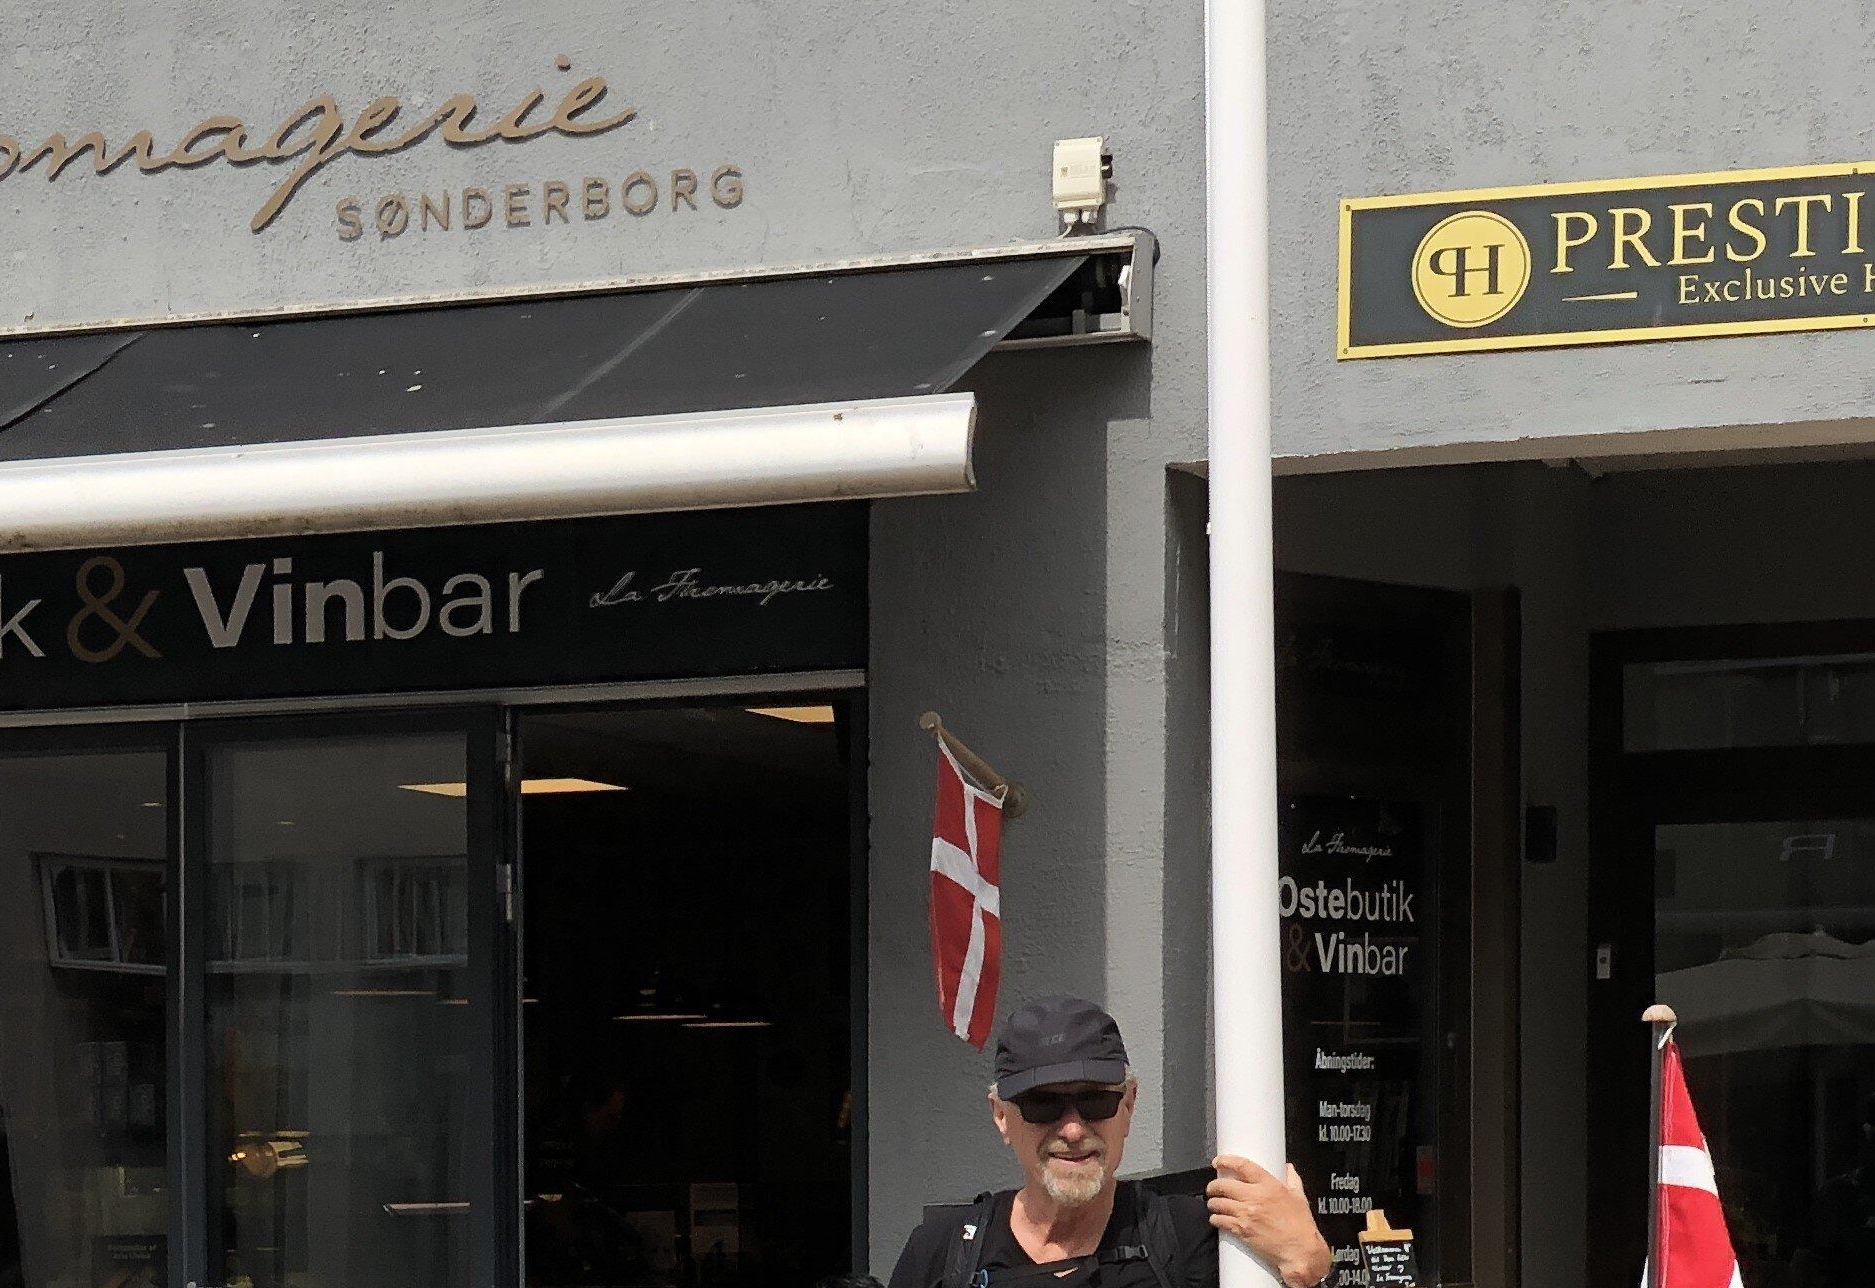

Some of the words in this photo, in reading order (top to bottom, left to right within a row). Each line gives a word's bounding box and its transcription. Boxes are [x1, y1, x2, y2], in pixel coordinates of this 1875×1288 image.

[336, 166, 745, 242] SØNDERBORG
[1549, 192, 1866, 275] PRESTI
[1677, 266, 1848, 307] Exclusive
[66, 556, 162, 664] &
[183, 550, 545, 650] Vinbar
[1277, 875, 1414, 922] Ostebutik
[1315, 931, 1408, 975] Vinbar
[1330, 1172, 1360, 1193] Fredag
